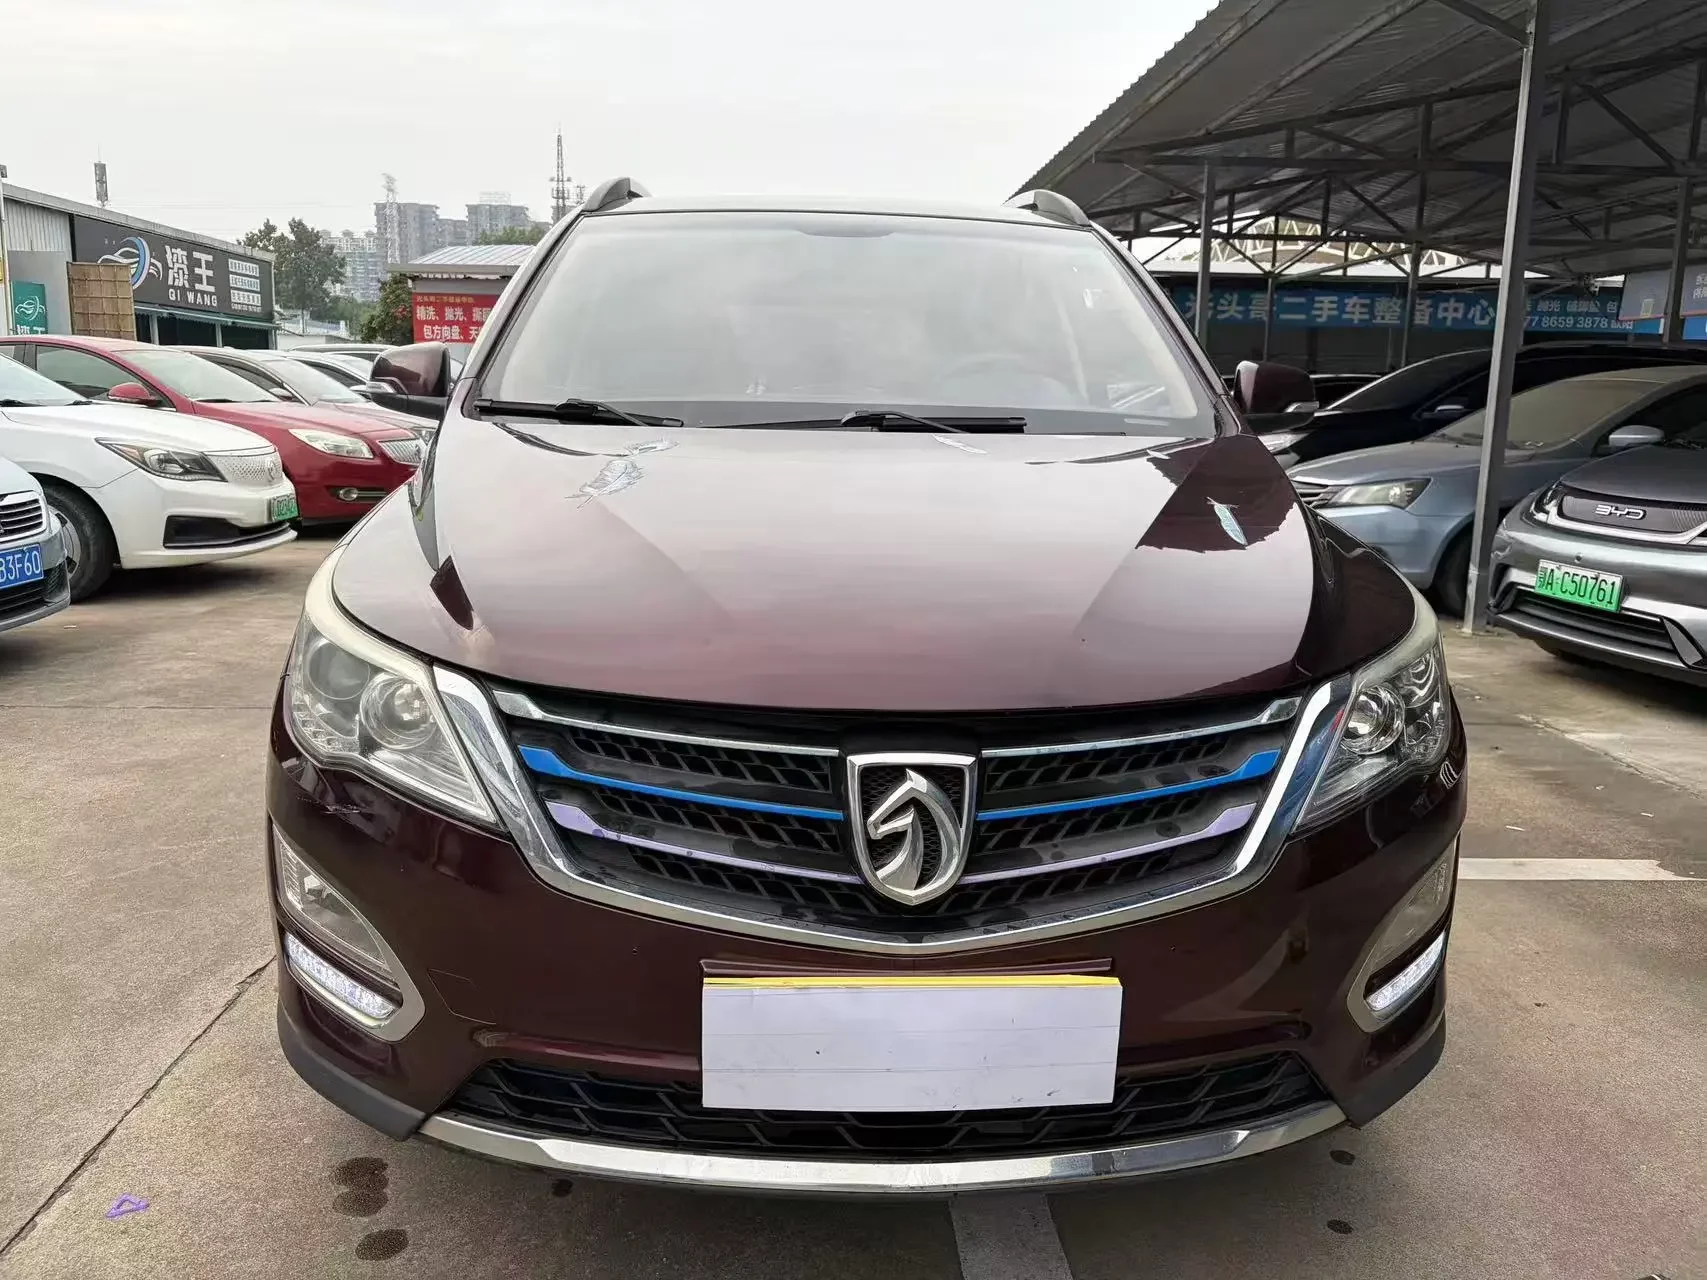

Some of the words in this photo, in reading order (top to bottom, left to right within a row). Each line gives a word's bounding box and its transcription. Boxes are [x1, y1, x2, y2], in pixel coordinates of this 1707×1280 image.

[165, 245, 216, 292] 漆王
[168, 288, 181, 301] QI
[186, 290, 218, 307] WANG
[1541, 316, 1574, 328] 8659
[1576, 317, 1608, 329] 3878
[423, 324, 482, 340] 包方向盘、天
[1595, 504, 1643, 519] BYD
